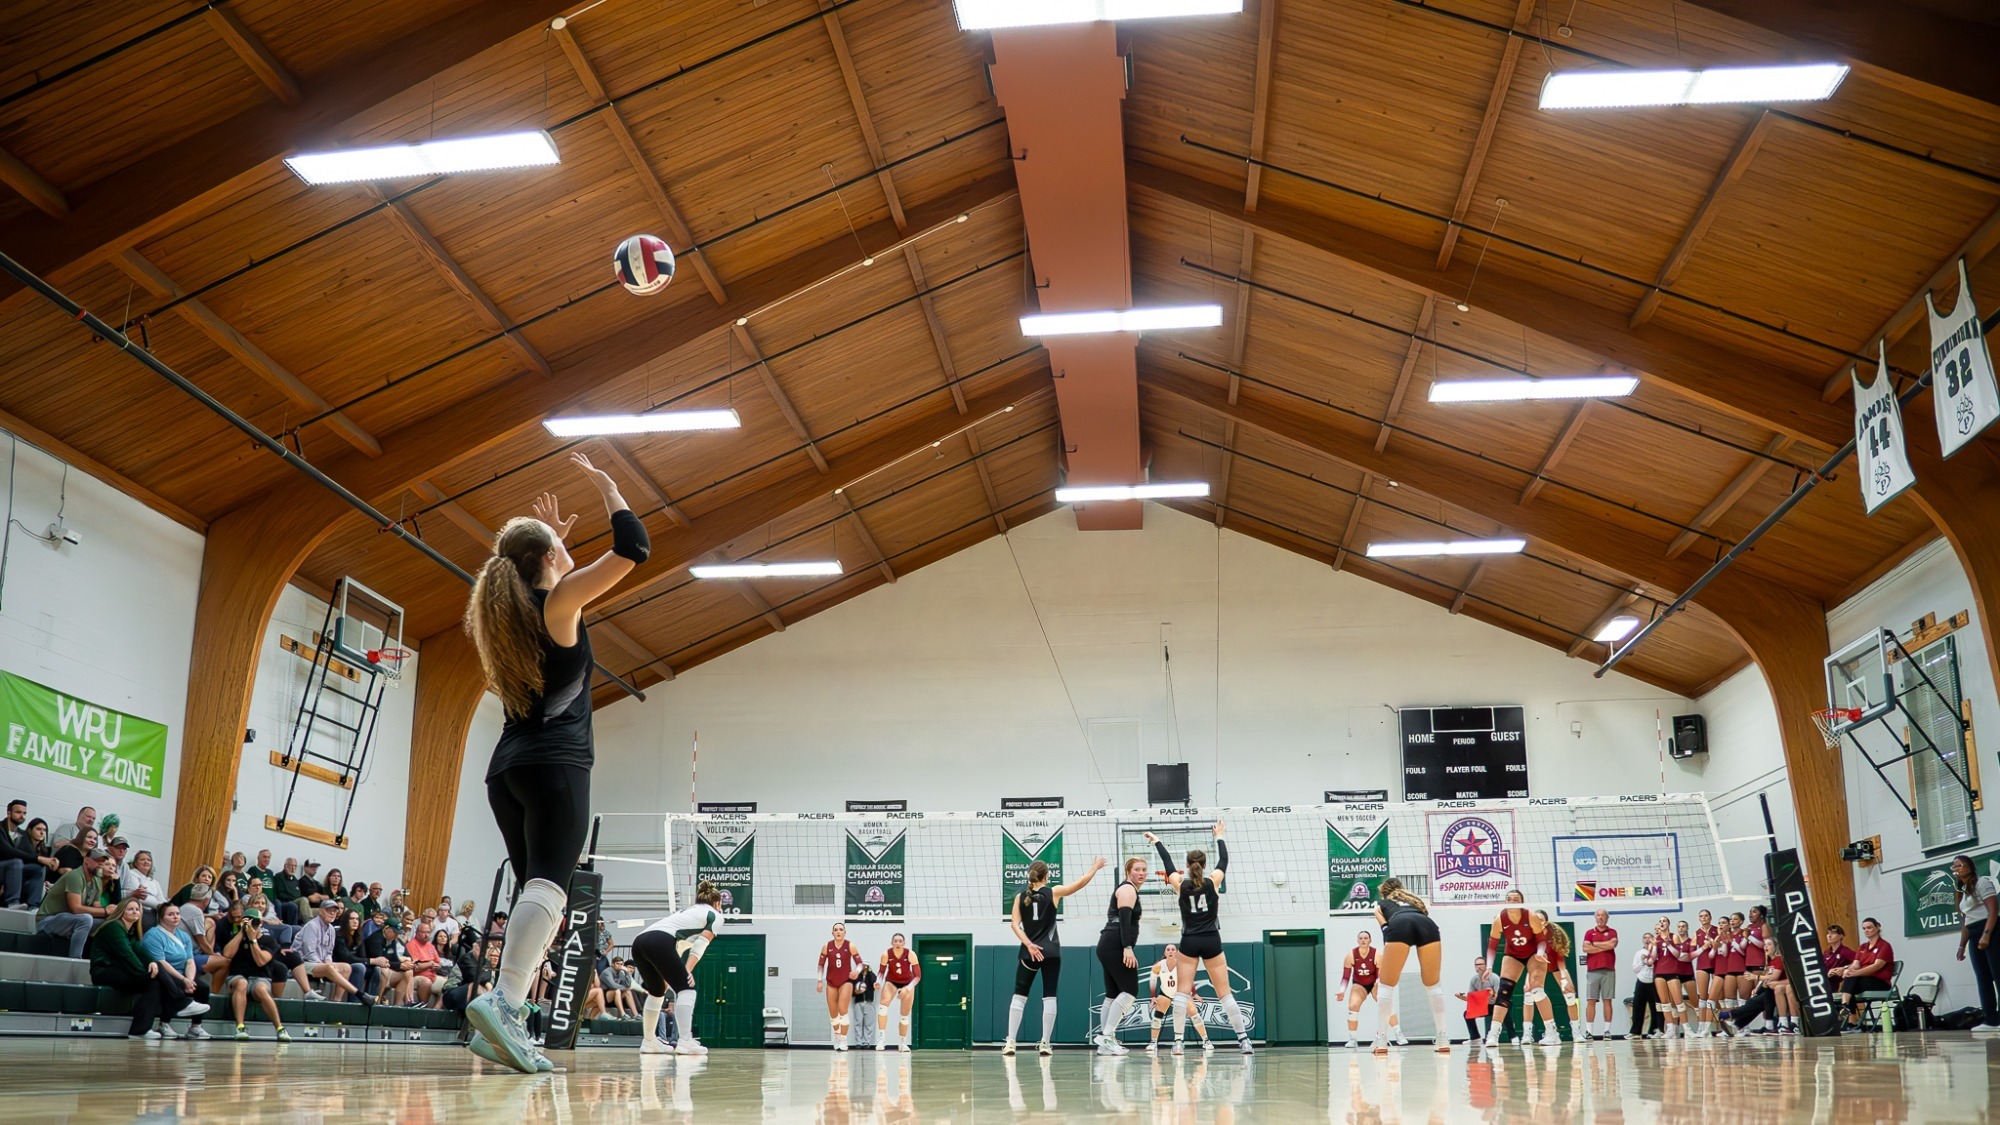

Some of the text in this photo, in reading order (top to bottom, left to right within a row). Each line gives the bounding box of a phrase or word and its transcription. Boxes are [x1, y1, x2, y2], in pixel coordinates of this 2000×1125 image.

[1945, 347, 1973, 398] 32
[1870, 417, 1890, 458] 44
[56, 694, 122, 749] WPU
[1408, 734, 1435, 744] HOME
[1490, 732, 1520, 741] GUEST
[6, 722, 153, 790] FAMILY ZONE
[1506, 764, 1526, 772] FOULS
[1406, 792, 1427, 800] SCORE
[1440, 856, 1506, 871] USA SOUTH
[1602, 855, 1641, 866] Division
[1330, 864, 1387, 872] CHAMPIONS
[698, 873, 750, 881] CHAMPIONS
[1440, 880, 1509, 891] #SPORTSMANSHIP
[1599, 886, 1662, 897] ONETEAM
[1189, 893, 1208, 913] 14
[1032, 902, 1038, 920] 1
[1511, 937, 1527, 946] 23
[1784, 891, 1832, 1018] PACERS
[836, 960, 842, 968] 8
[551, 910, 588, 1030] PACERS
